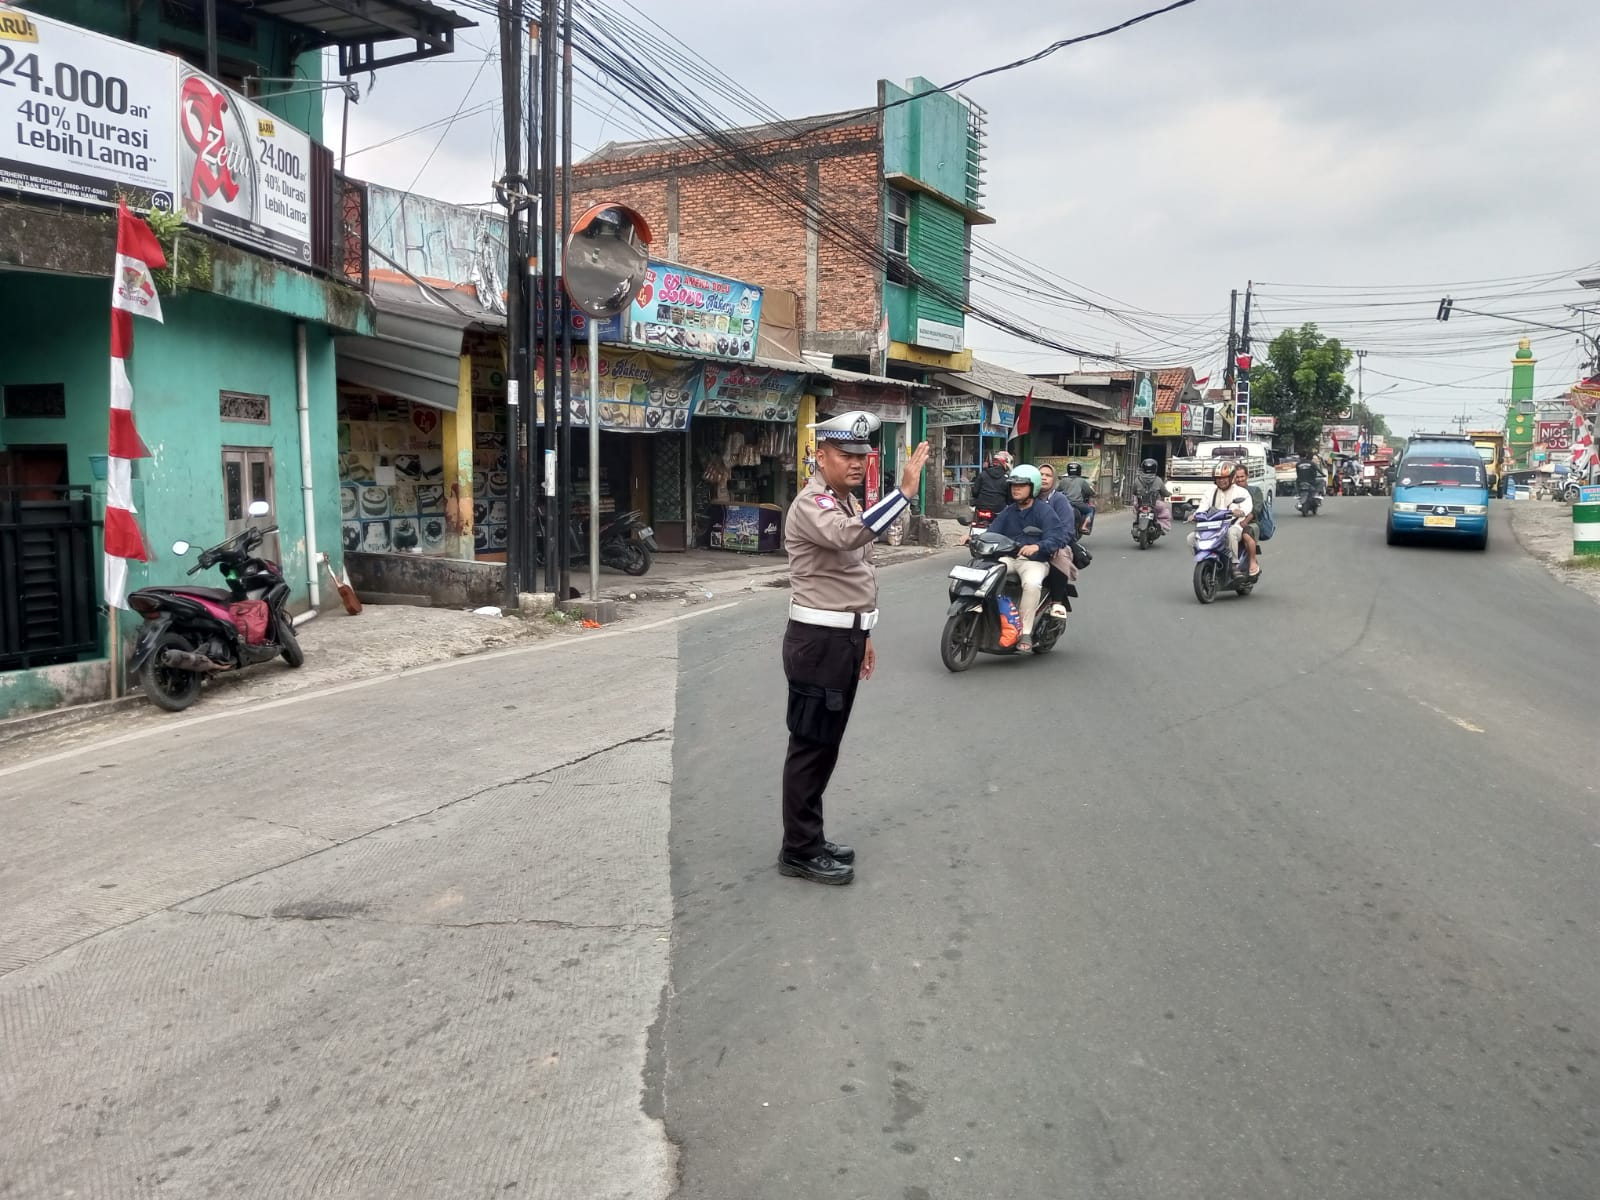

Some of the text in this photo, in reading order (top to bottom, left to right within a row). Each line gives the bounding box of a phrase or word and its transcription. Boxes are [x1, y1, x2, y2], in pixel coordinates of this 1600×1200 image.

[17, 99, 149, 149] 40% Durasi
[17, 122, 83, 157] Lebih
[264, 173, 306, 204] 40% Durasi
[264, 194, 285, 216] Lebih
[658, 273, 704, 309] Love
[705, 293, 735, 316] Bakery
[611, 359, 653, 384] Bakery
[1541, 427, 1569, 438] NICE
